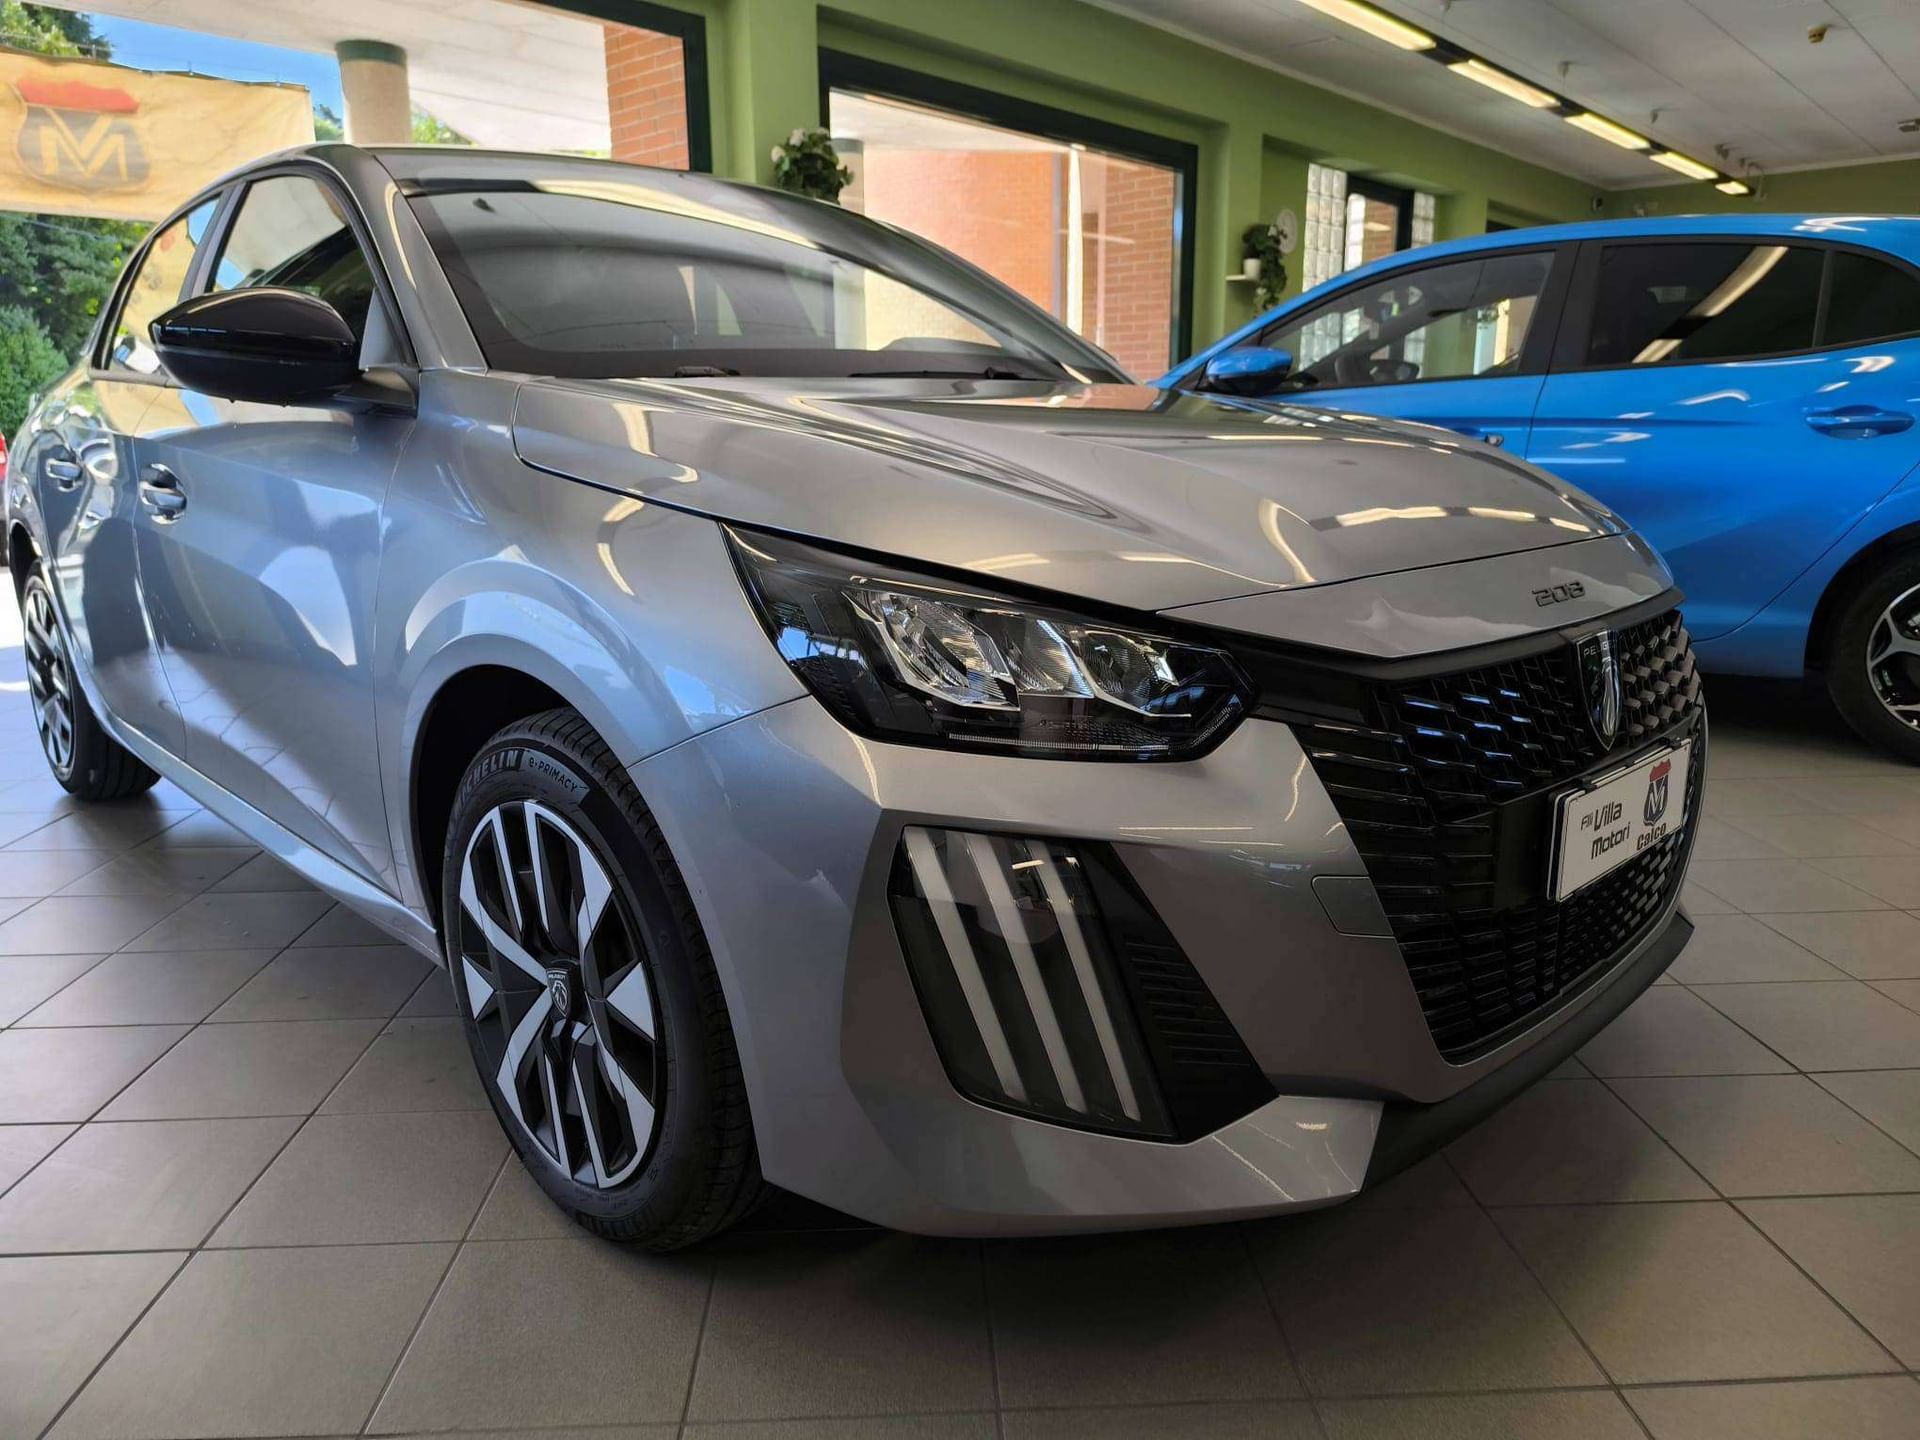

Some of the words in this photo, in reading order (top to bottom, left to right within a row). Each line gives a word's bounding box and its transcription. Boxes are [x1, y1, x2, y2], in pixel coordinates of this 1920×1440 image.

[1532, 581, 1585, 607] 208
[1593, 801, 1623, 831] Villa
[1591, 821, 1631, 860] Motori
[1635, 822, 1667, 851] Calco
